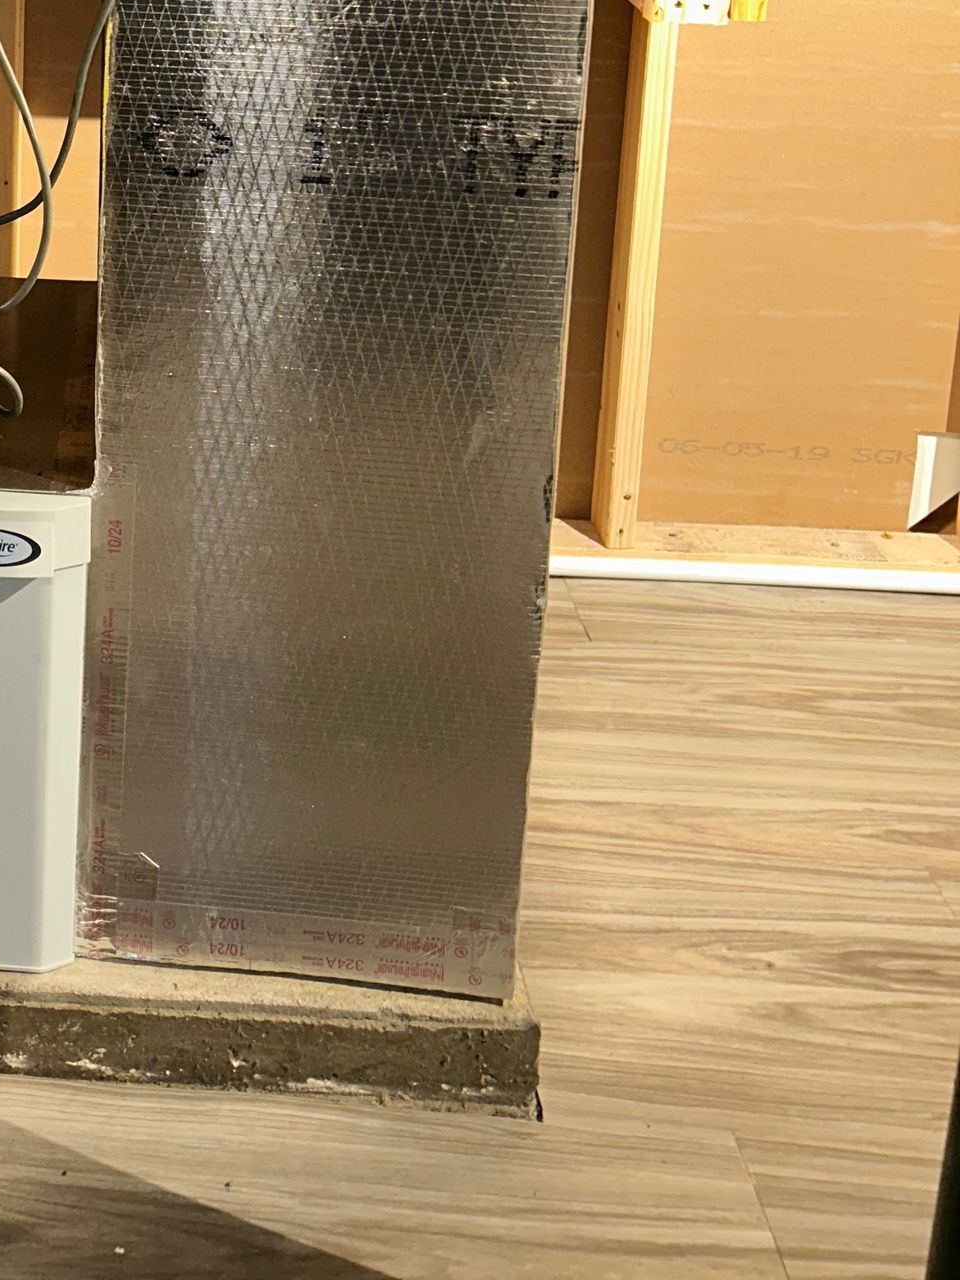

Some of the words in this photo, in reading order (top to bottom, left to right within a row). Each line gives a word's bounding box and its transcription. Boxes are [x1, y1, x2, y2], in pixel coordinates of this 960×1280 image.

[107, 520, 122, 555] 10/24
[209, 916, 246, 931] 10/24
[326, 930, 366, 946] 324A
[209, 942, 246, 957] 10/24
[326, 956, 365, 971] 324A
